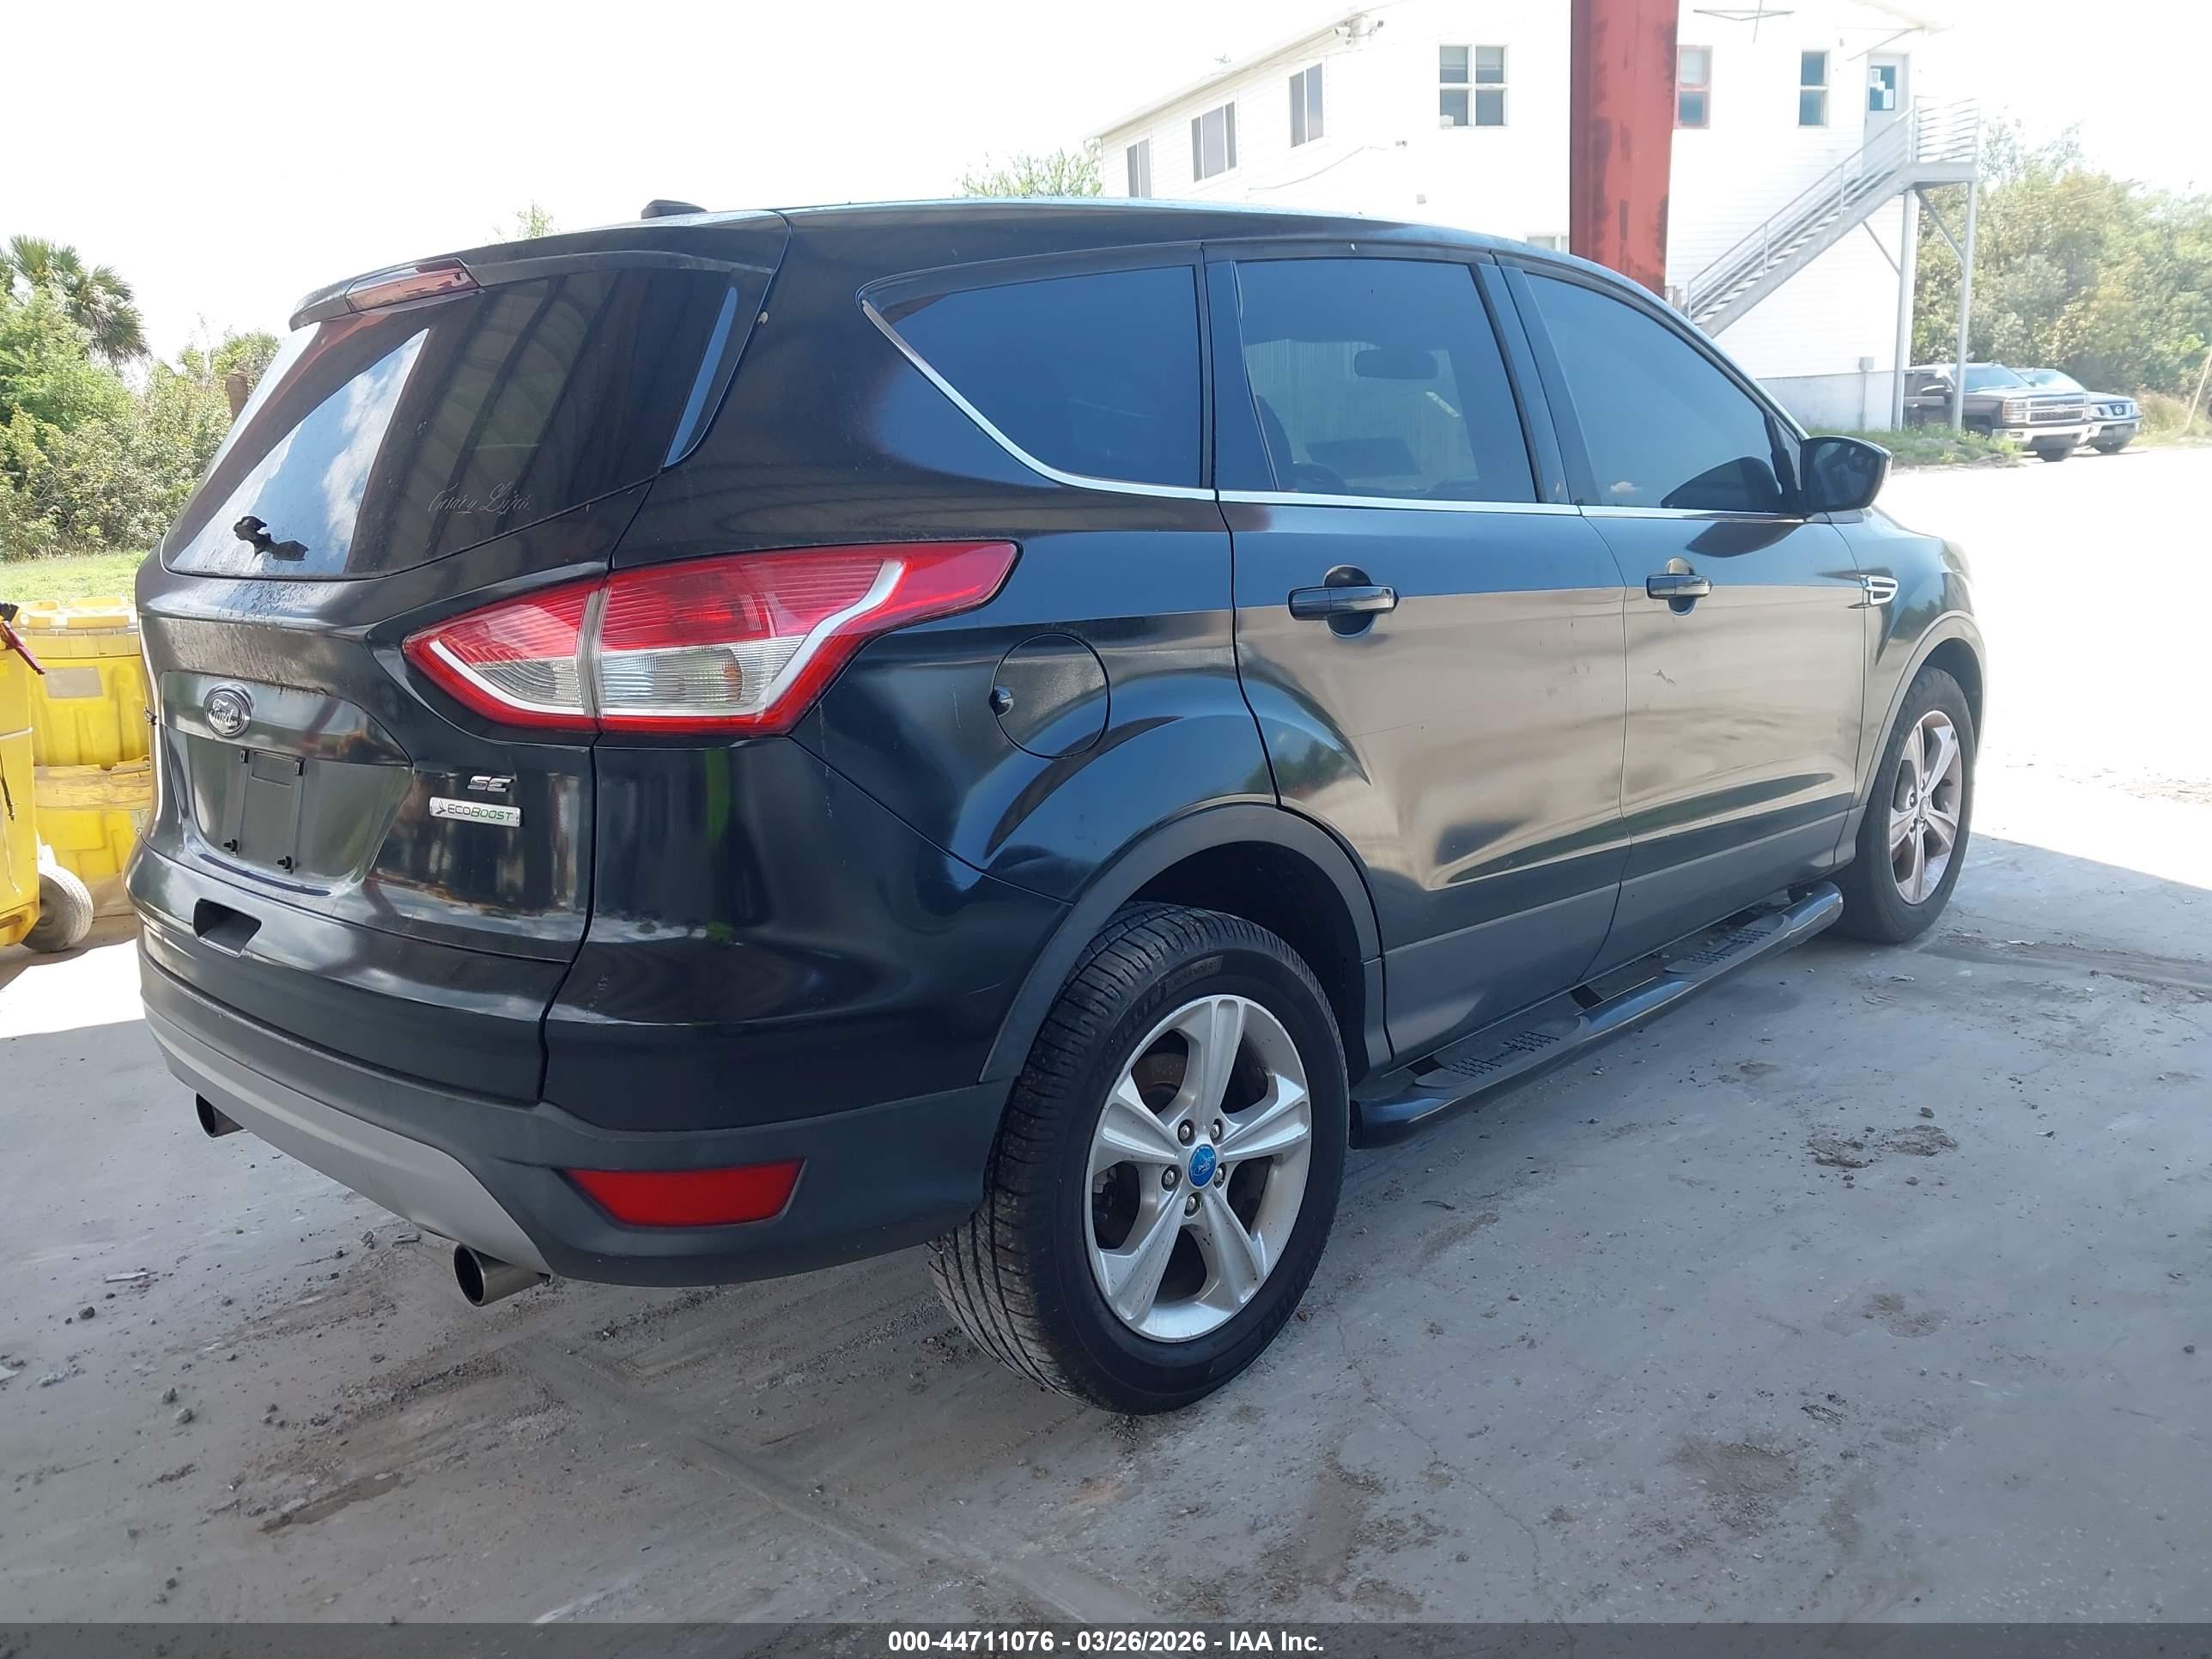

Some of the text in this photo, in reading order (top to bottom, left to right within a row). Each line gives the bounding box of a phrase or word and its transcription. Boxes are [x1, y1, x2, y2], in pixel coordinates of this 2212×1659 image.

[209, 698, 234, 726] Ford
[467, 775, 513, 793] SE
[447, 803, 514, 821] ECOBOOST
